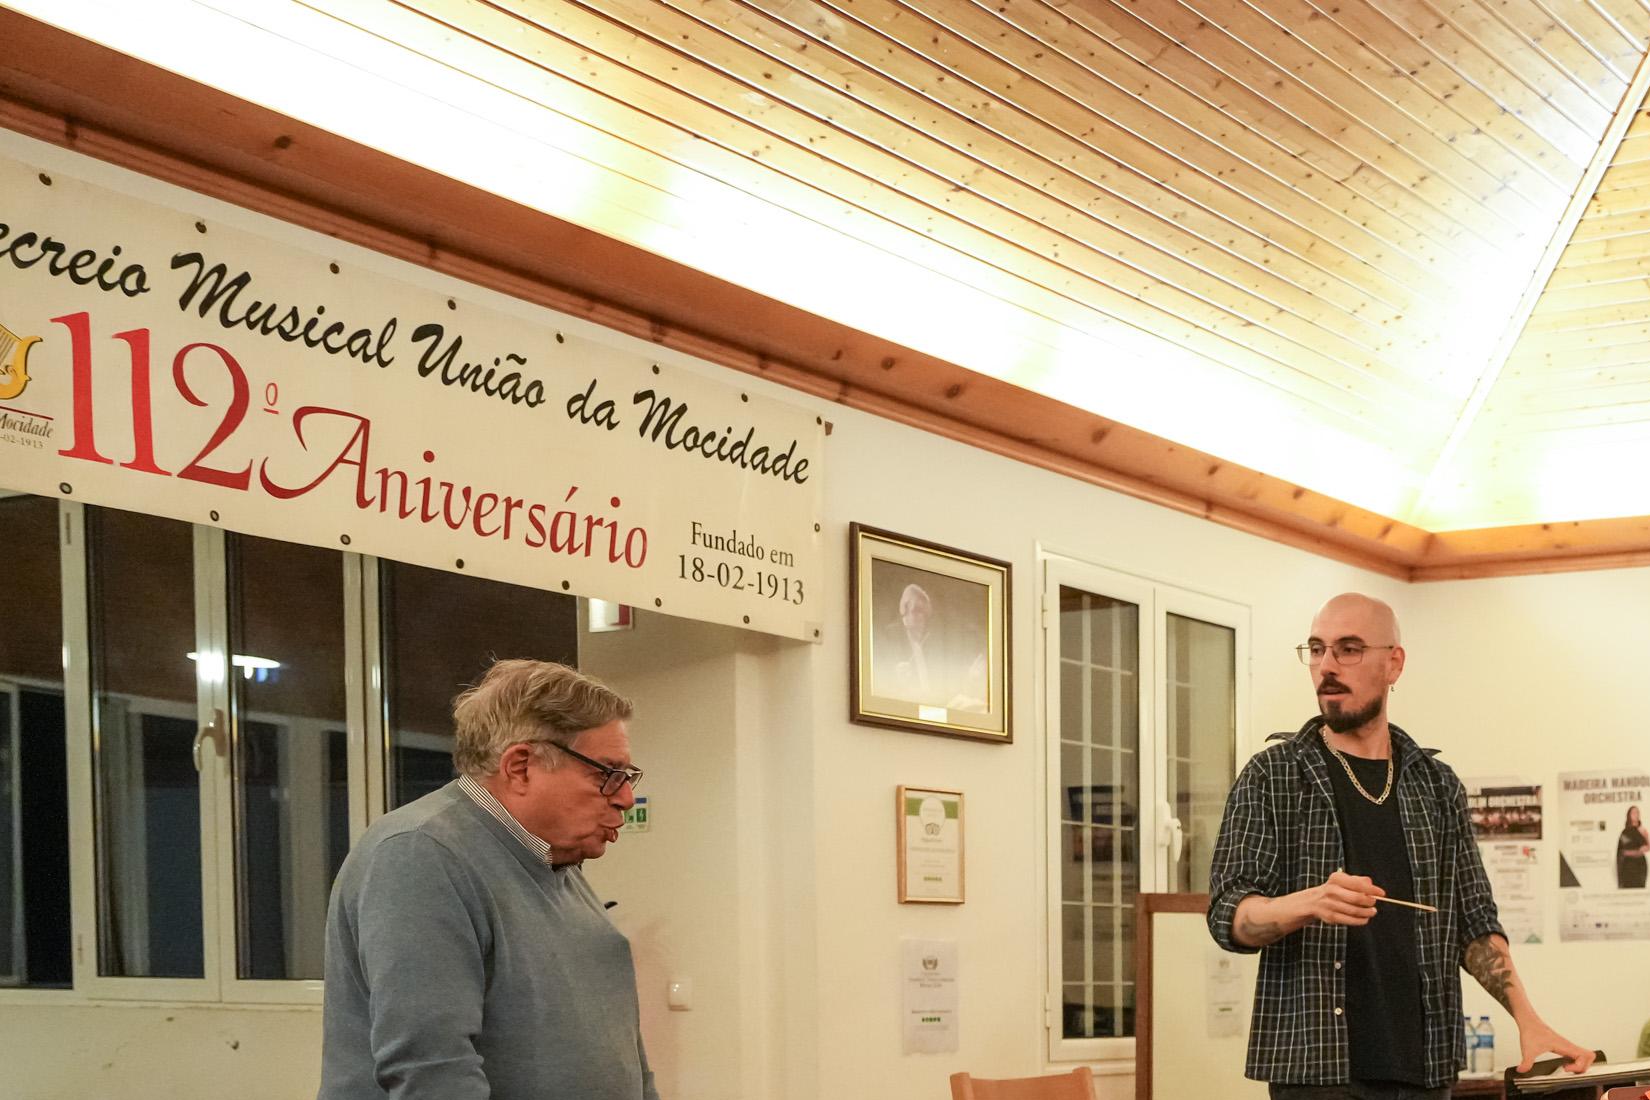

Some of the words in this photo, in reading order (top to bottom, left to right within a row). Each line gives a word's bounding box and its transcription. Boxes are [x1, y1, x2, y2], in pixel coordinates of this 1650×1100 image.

[171, 252, 397, 368] Musical
[411, 323, 545, 408] União
[567, 378, 620, 430] da
[633, 389, 809, 484] Mocidade
[259, 405, 648, 568] Aniversário
[691, 521, 765, 560] Fundado
[770, 549, 794, 568] em
[679, 554, 804, 605] 18-02-1913
[1563, 777, 1608, 791] MADEIRA
[1583, 791, 1643, 804] ORCHESTRA
